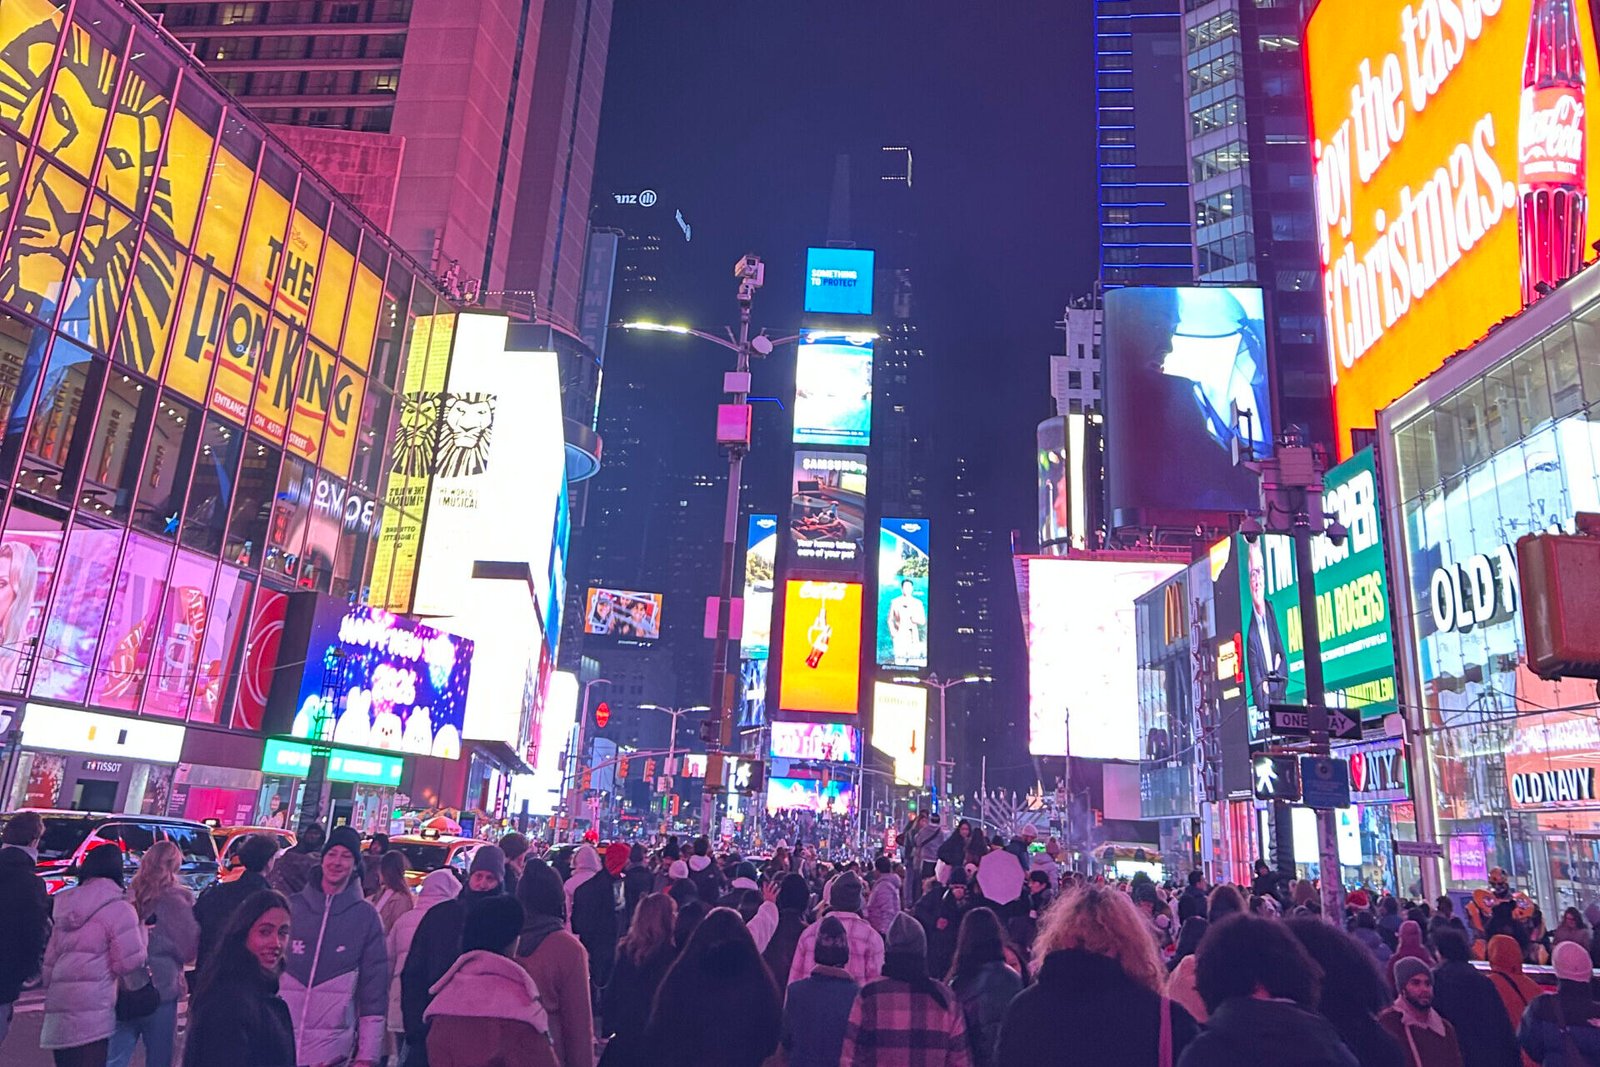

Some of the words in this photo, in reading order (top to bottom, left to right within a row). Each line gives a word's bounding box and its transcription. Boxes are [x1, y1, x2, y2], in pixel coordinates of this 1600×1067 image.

[1351, 54, 1405, 183] the
[1401, 0, 1503, 112] tas
[268, 235, 315, 306] THE
[1333, 113, 1515, 368] Christmas.
[823, 278, 857, 288] PROTECT
[185, 252, 280, 378] LION
[272, 313, 354, 425] KING
[213, 392, 248, 418] ENTRANCE
[253, 414, 265, 426] ON
[266, 420, 282, 436] 45TH
[289, 432, 308, 449] STREET
[803, 458, 857, 471] SAMSUNG
[1334, 571, 1384, 636] ROGERS
[1431, 554, 1496, 632] OLD
[1283, 714, 1308, 726] ONE
[97, 761, 122, 773] TISSOT
[1512, 772, 1543, 805] OLD
[1543, 767, 1592, 801] NAVY
